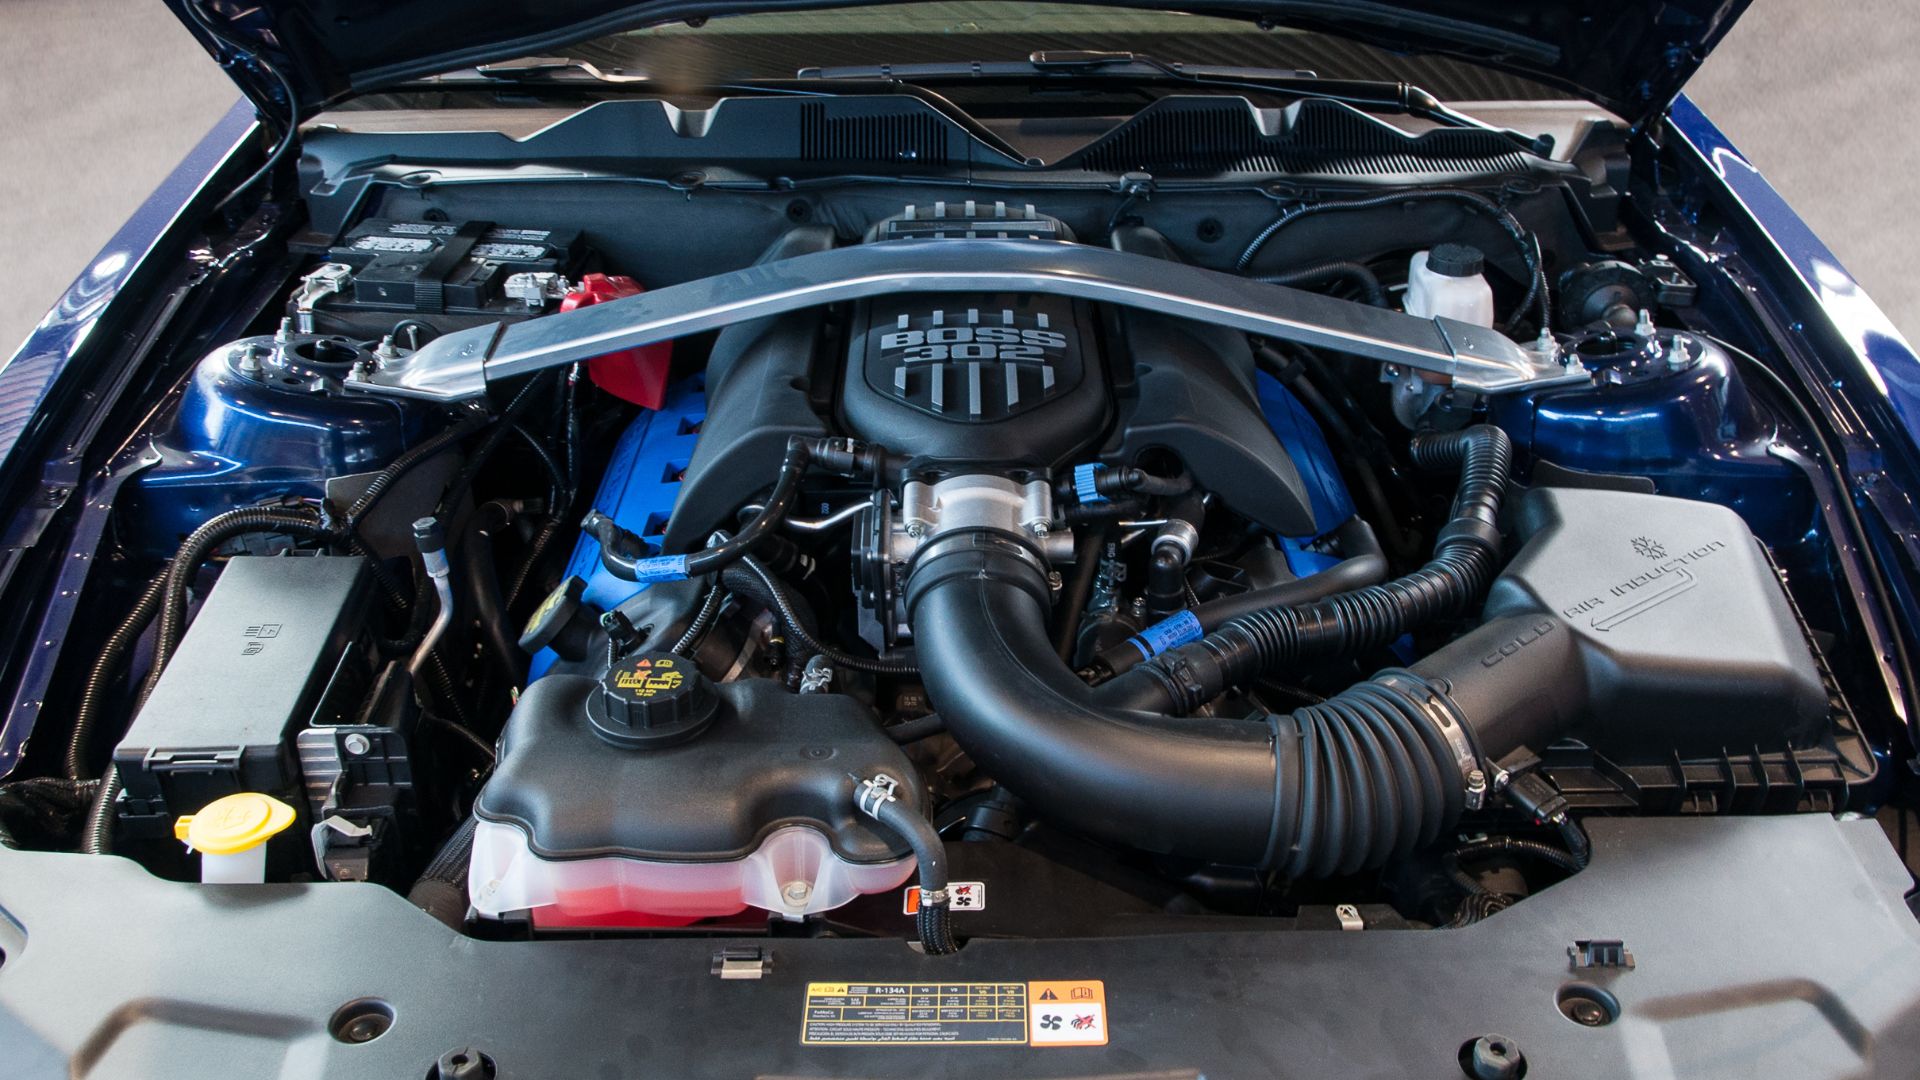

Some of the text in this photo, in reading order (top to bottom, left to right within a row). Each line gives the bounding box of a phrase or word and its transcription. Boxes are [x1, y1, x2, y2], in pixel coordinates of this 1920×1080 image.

[881, 327, 1067, 349] BOSS
[904, 344, 1045, 363] 302
[1481, 540, 1726, 668] COLD AIR INDUCTION
